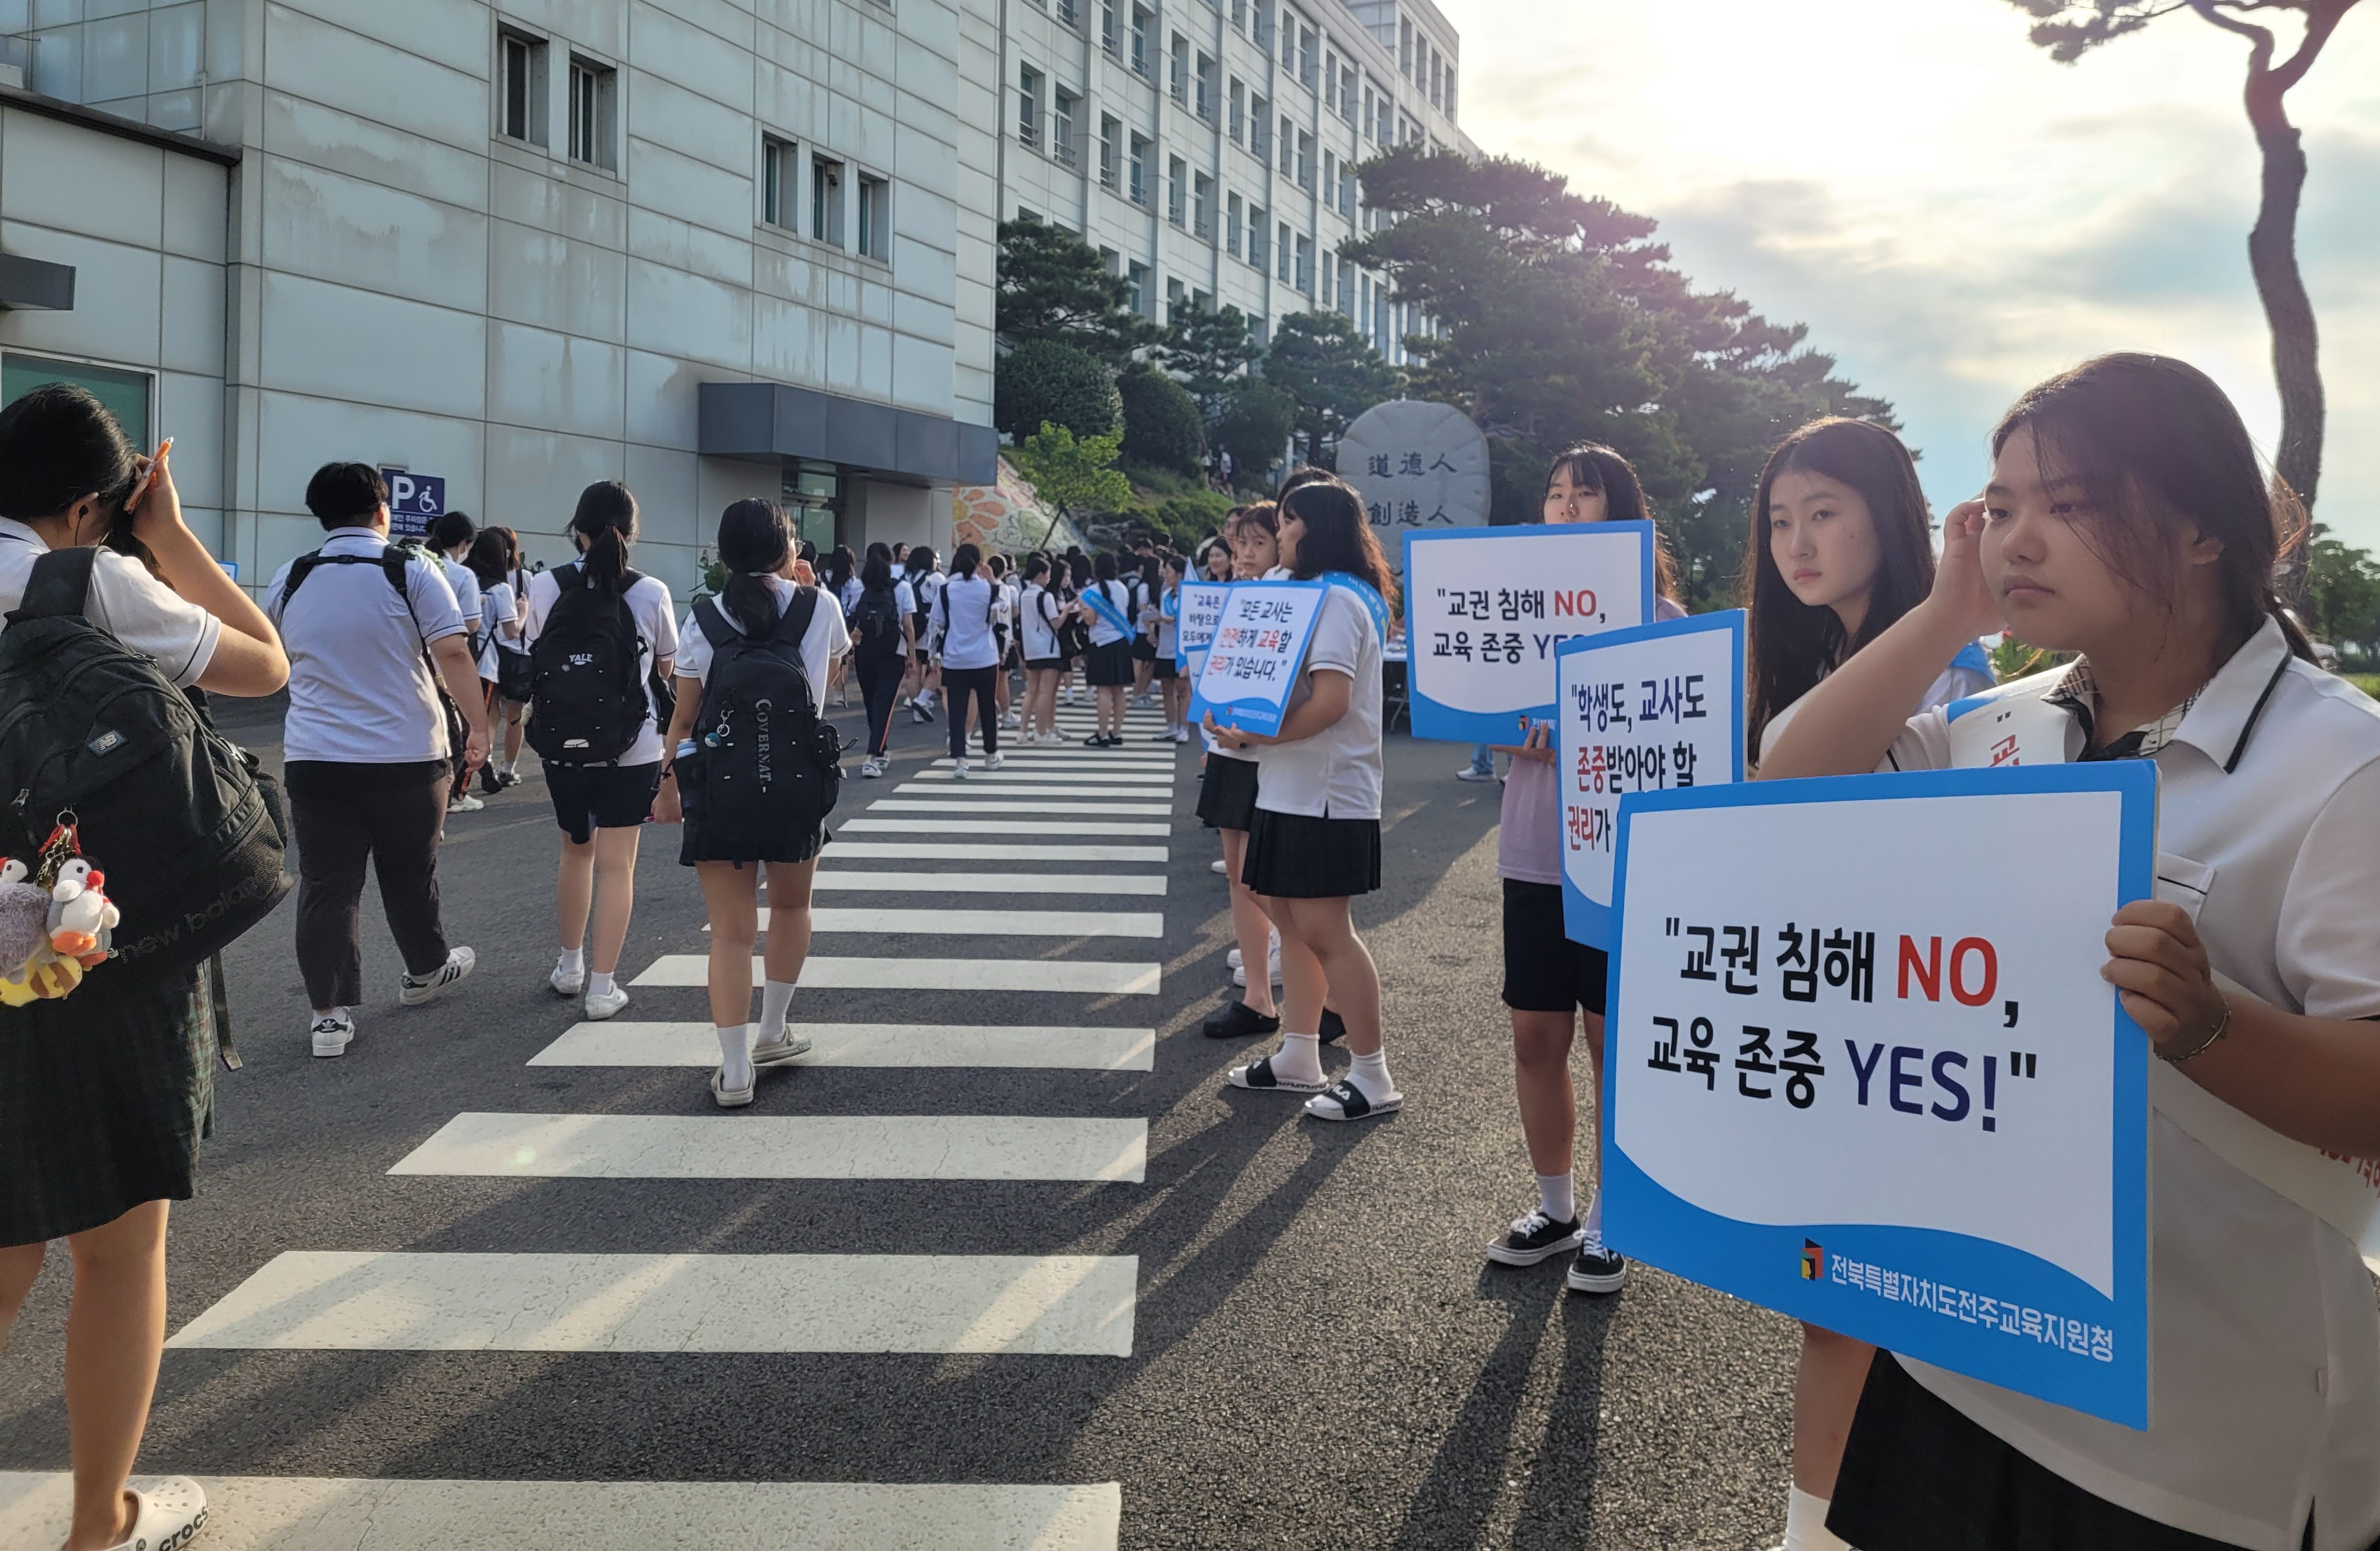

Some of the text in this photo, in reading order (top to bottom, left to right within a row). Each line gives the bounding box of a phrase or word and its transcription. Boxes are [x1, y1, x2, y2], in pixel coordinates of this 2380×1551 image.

[392, 475, 415, 509] P
[1367, 500, 1454, 526] 創造人
[1260, 601, 1293, 623] 교사는
[1437, 588, 1606, 624] "교권 침해 NO,
[1257, 629, 1292, 653] 교육할
[1433, 631, 1473, 662] 교육
[1480, 633, 1525, 665] 존중
[1571, 675, 1706, 733] "학생도, 교사도
[756, 699, 773, 781] COVERNAT
[1577, 740, 1697, 794] 존중받아야 할
[1568, 806, 1611, 853] 권리가
[1666, 917, 2019, 1028] "교권 침해 NO,
[1647, 1016, 2037, 1133] 교육 존중 YES!"
[1832, 1254, 2114, 1363] 전북특별자치도전주교육지원청
[158, 1506, 208, 1551] crocs
